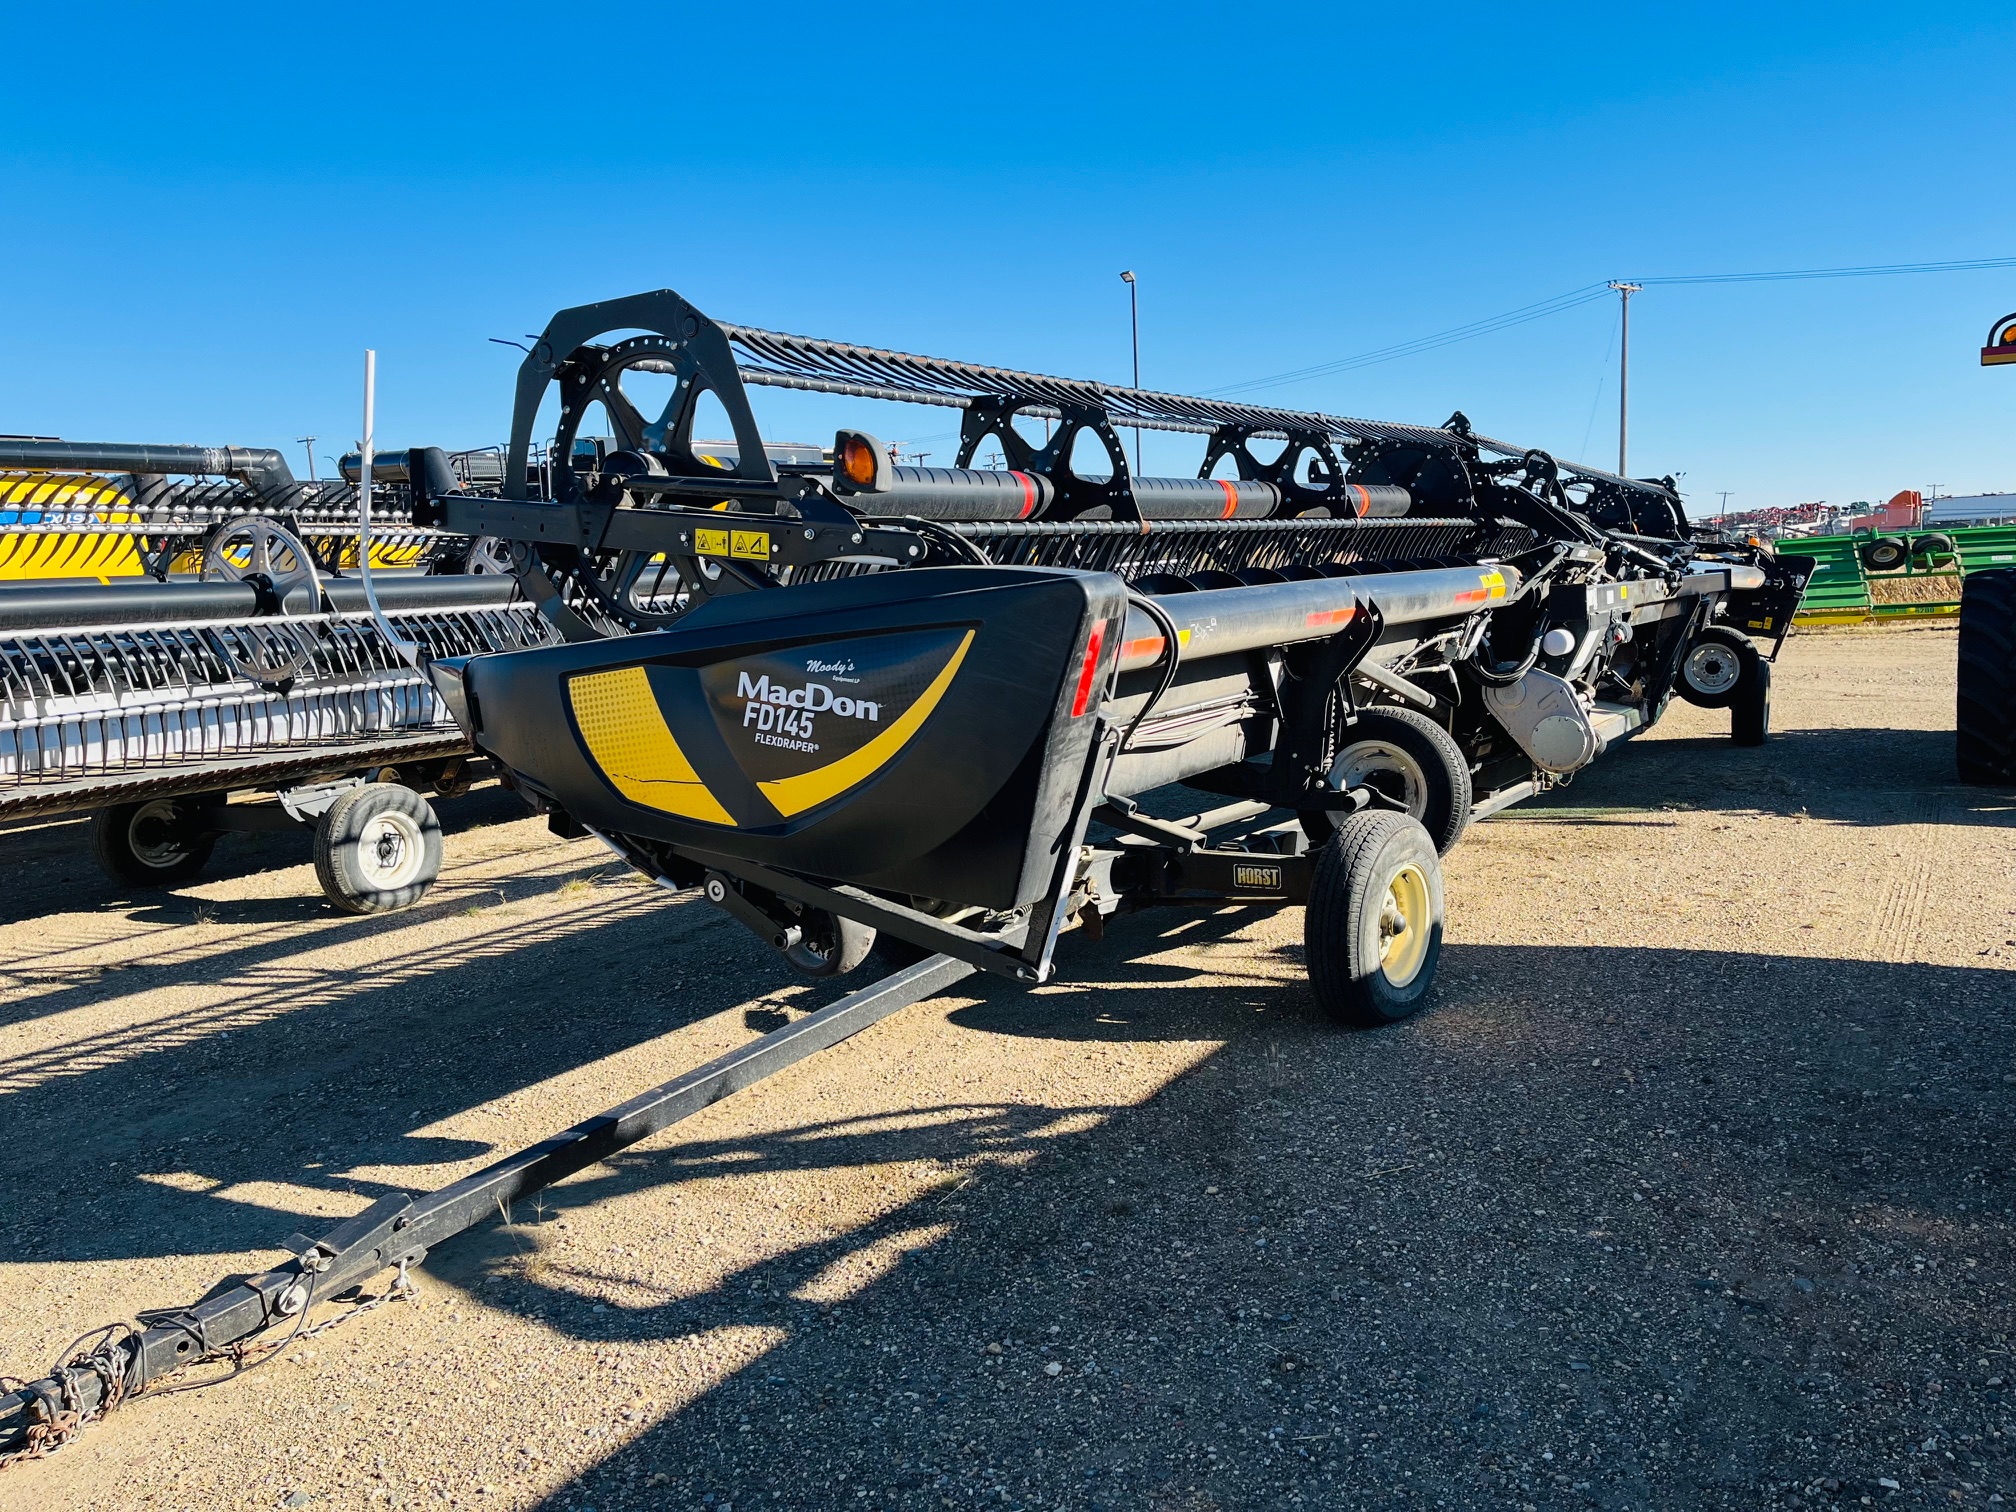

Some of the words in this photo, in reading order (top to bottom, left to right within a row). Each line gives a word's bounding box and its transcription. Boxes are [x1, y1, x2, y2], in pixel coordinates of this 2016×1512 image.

[806, 659, 855, 675] Moody's
[742, 701, 815, 739] FD145
[1237, 867, 1279, 886] HORST
